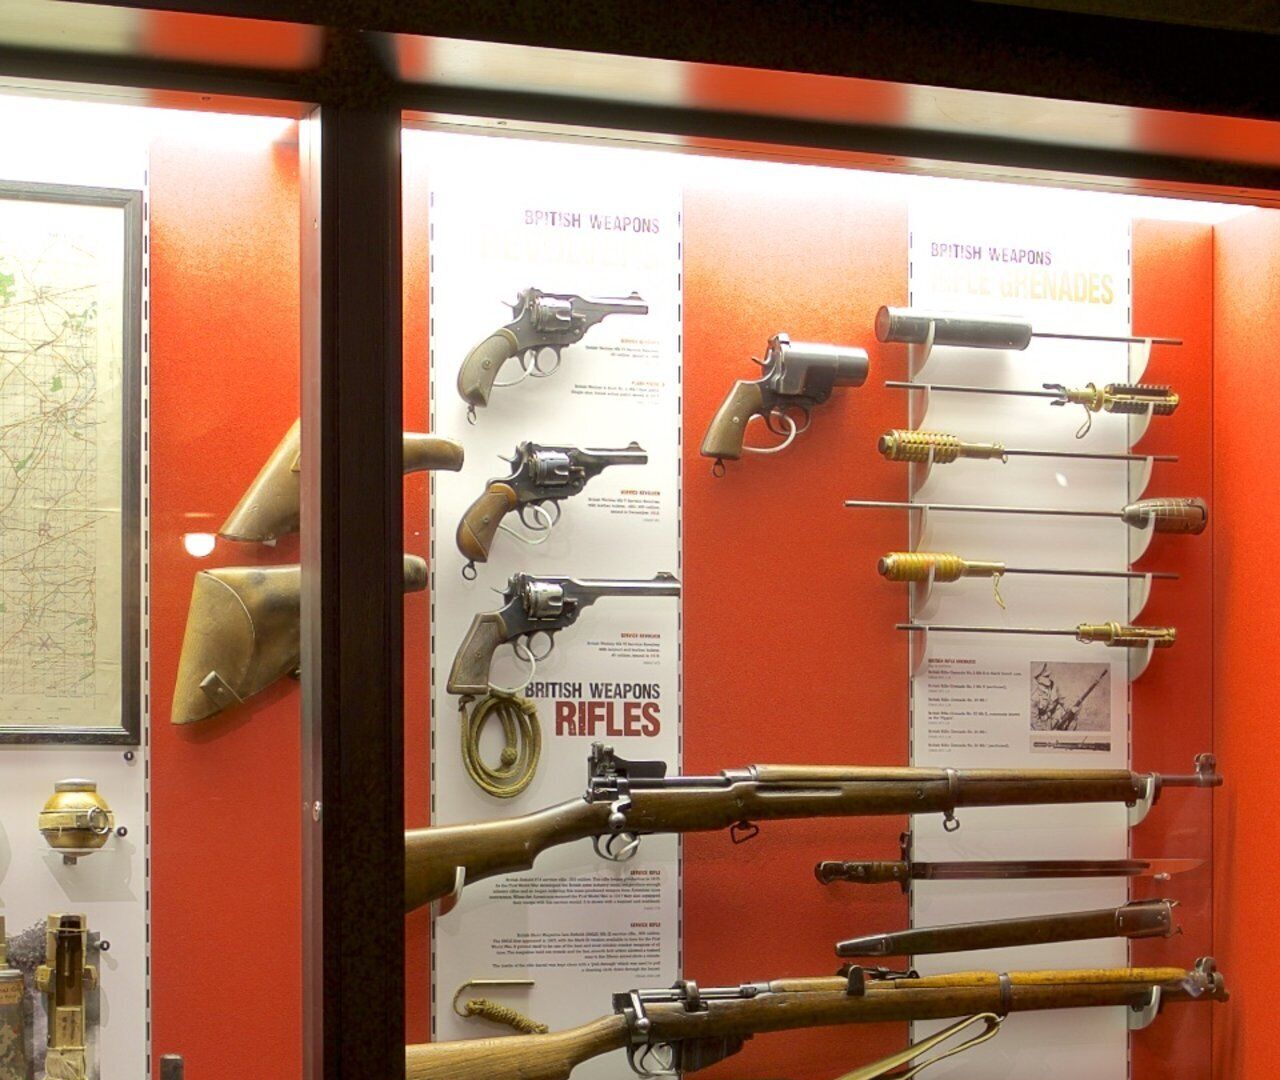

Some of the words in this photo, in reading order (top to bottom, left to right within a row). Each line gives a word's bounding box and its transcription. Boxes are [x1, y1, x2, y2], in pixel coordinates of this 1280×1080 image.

[931, 242, 982, 260] BRITISH
[989, 247, 1051, 265] WEAPONS
[525, 682, 581, 698] BRITISH
[589, 683, 660, 699] WEAPONS
[556, 701, 660, 737] RIFLES
